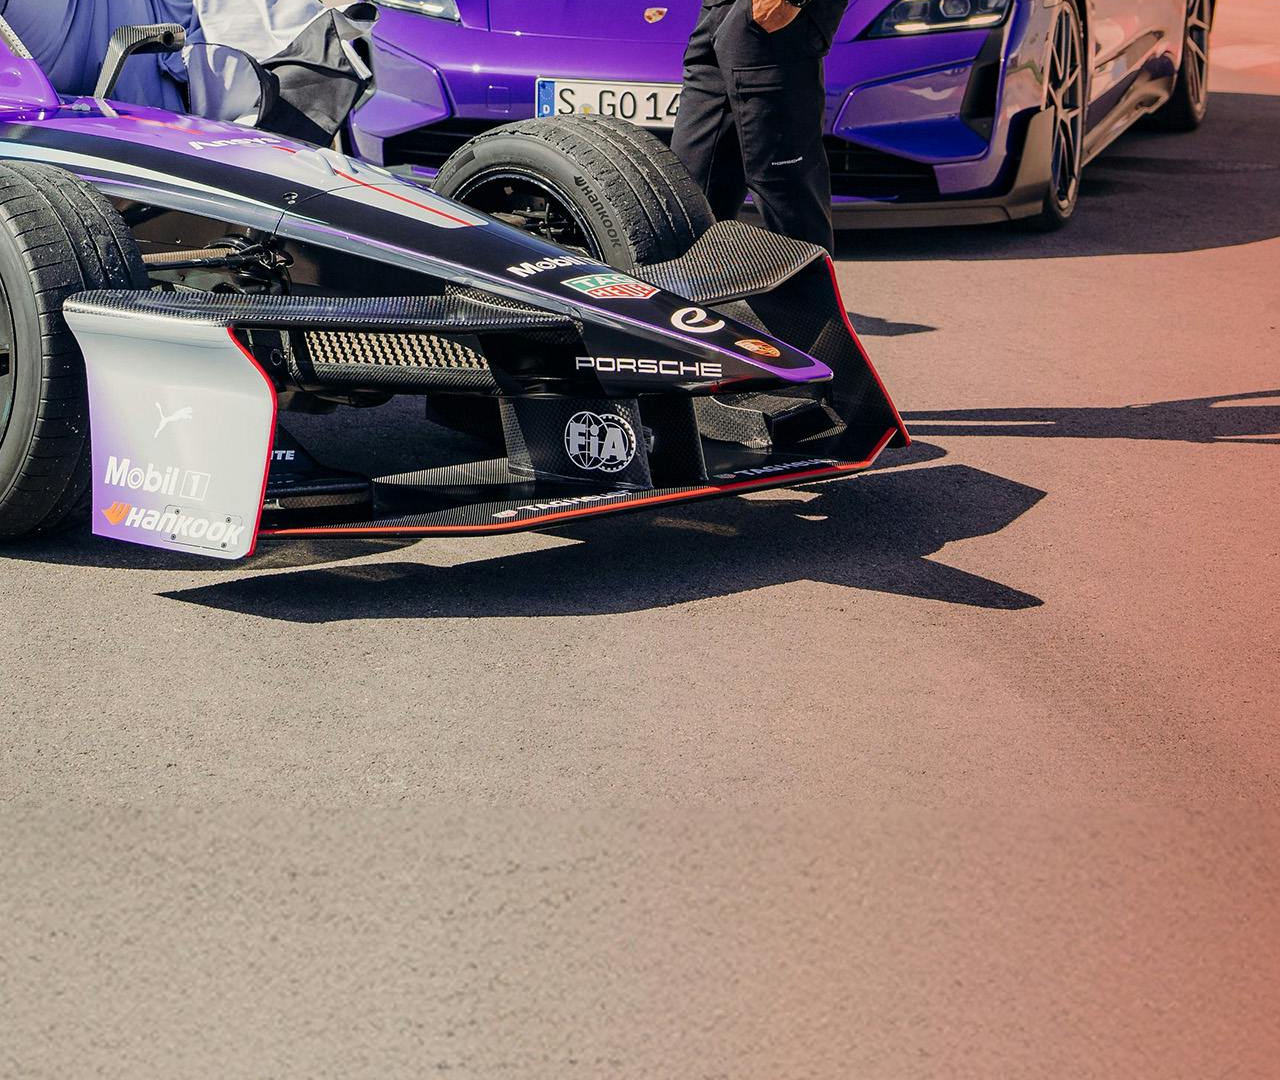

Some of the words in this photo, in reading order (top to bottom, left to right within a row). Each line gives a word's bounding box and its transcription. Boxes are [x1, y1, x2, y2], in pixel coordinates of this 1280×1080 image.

[558, 88, 575, 114] S
[506, 255, 586, 278] Mobil
[575, 356, 723, 377] PORSCHE
[104, 455, 180, 496] Mobil
[124, 506, 246, 545] Hankook
